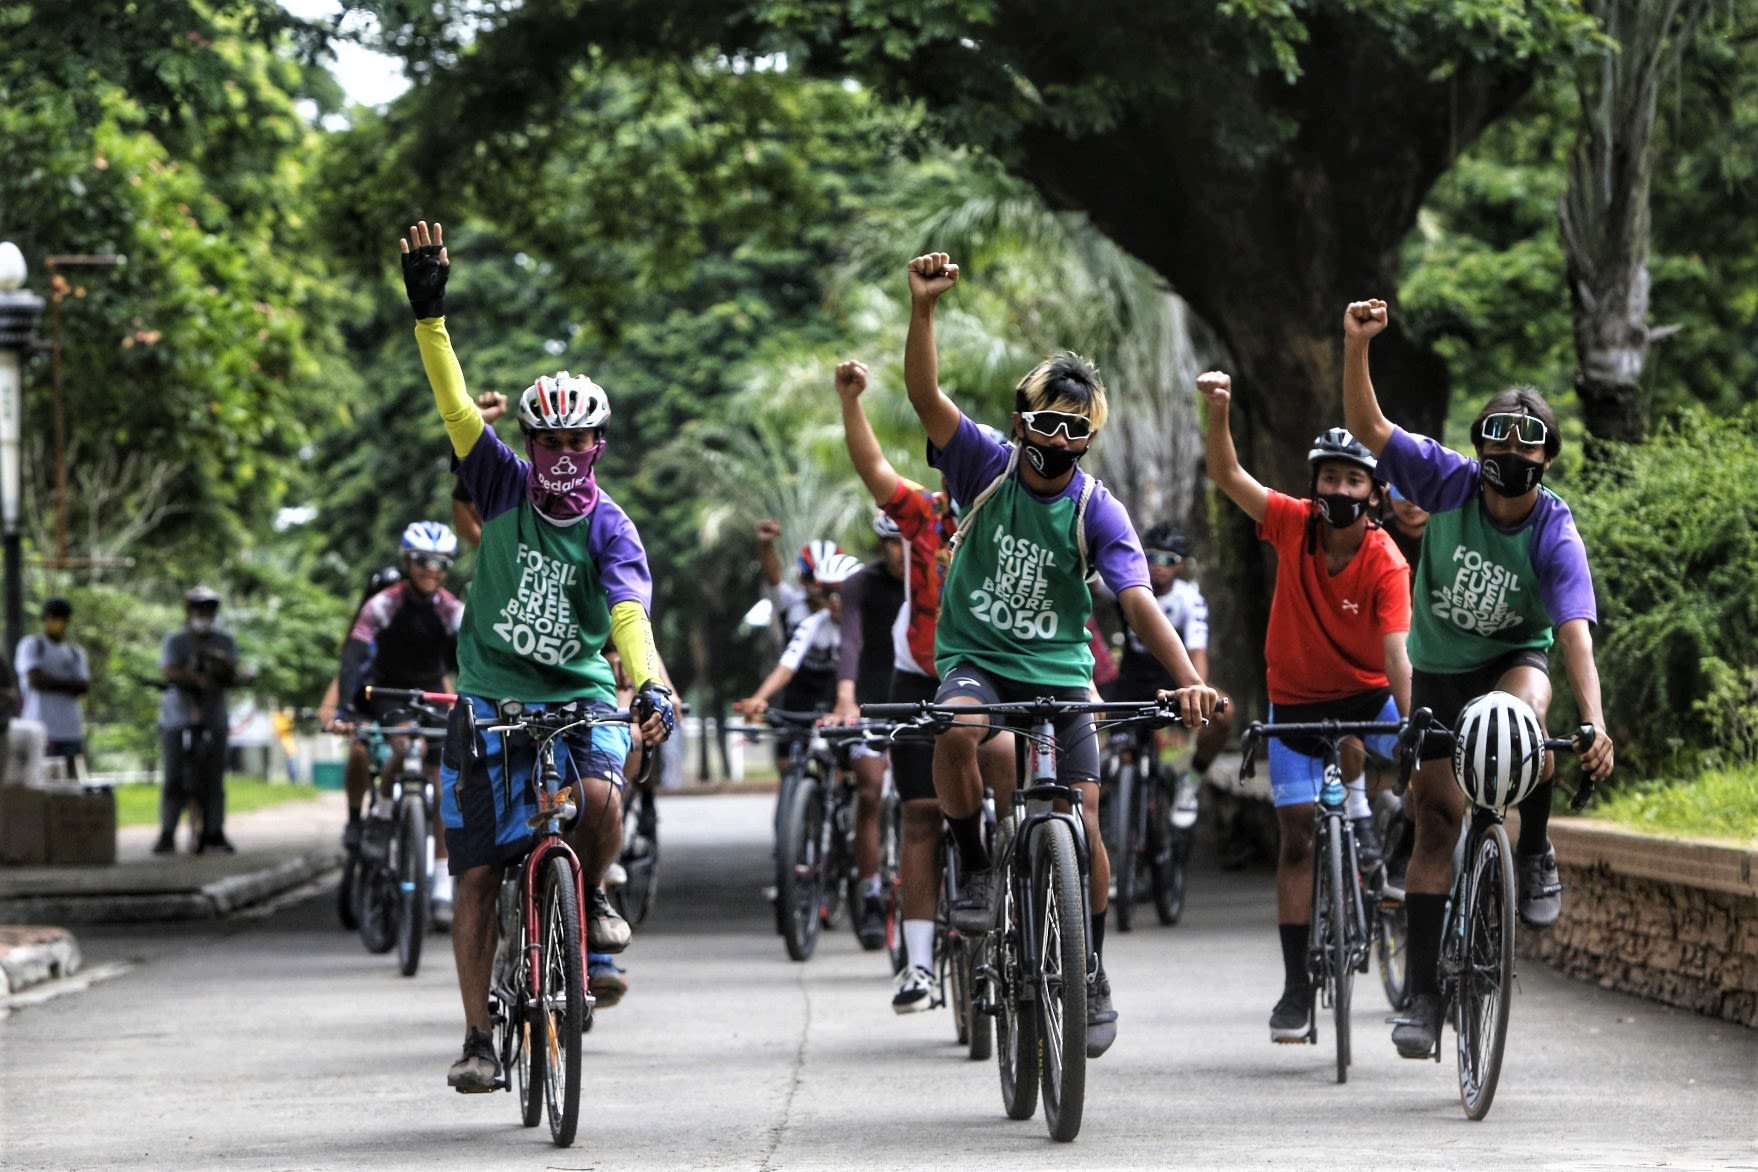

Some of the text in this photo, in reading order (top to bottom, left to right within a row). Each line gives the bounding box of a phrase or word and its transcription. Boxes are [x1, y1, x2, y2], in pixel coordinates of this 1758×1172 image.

[516, 542, 577, 586] FOSSIL
[993, 524, 1056, 567] FOSSIL
[998, 548, 1048, 582] FUEL
[520, 567, 569, 602] FUEL
[1453, 544, 1520, 592] FOSSIL
[1457, 567, 1506, 605] FUEL
[506, 598, 579, 639] BEFORE
[517, 587, 570, 624] FREE
[969, 589, 1058, 639] 2050
[1431, 589, 1524, 637] 2050
[492, 608, 581, 665] 2050
